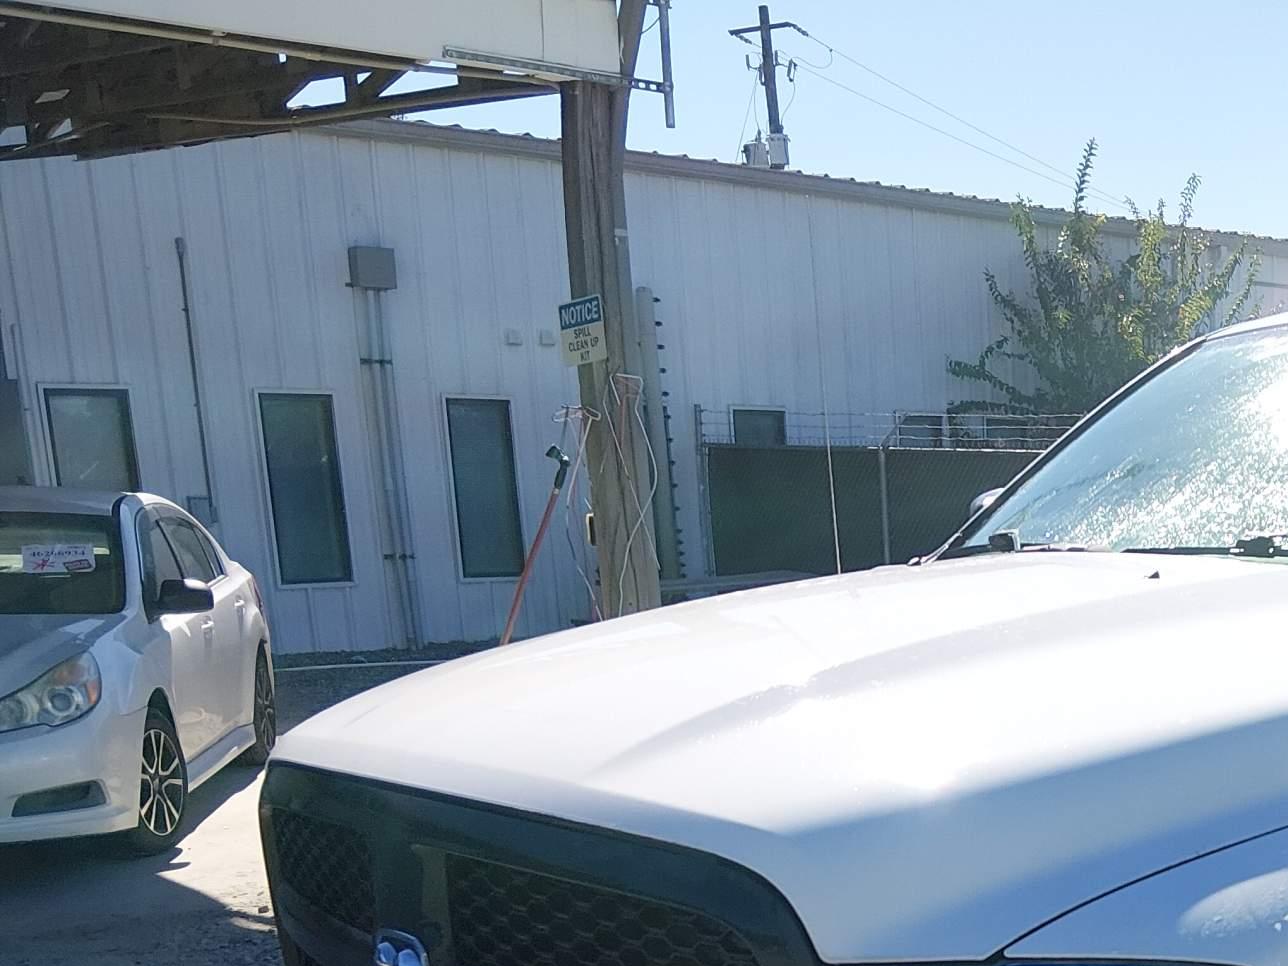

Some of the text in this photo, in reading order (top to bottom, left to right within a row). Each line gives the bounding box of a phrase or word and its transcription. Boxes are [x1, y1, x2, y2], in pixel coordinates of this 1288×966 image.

[561, 301, 599, 326] NOTICE
[573, 326, 592, 339] SPILL
[568, 337, 599, 352] CLEAN UP
[580, 351, 590, 361] KIT
